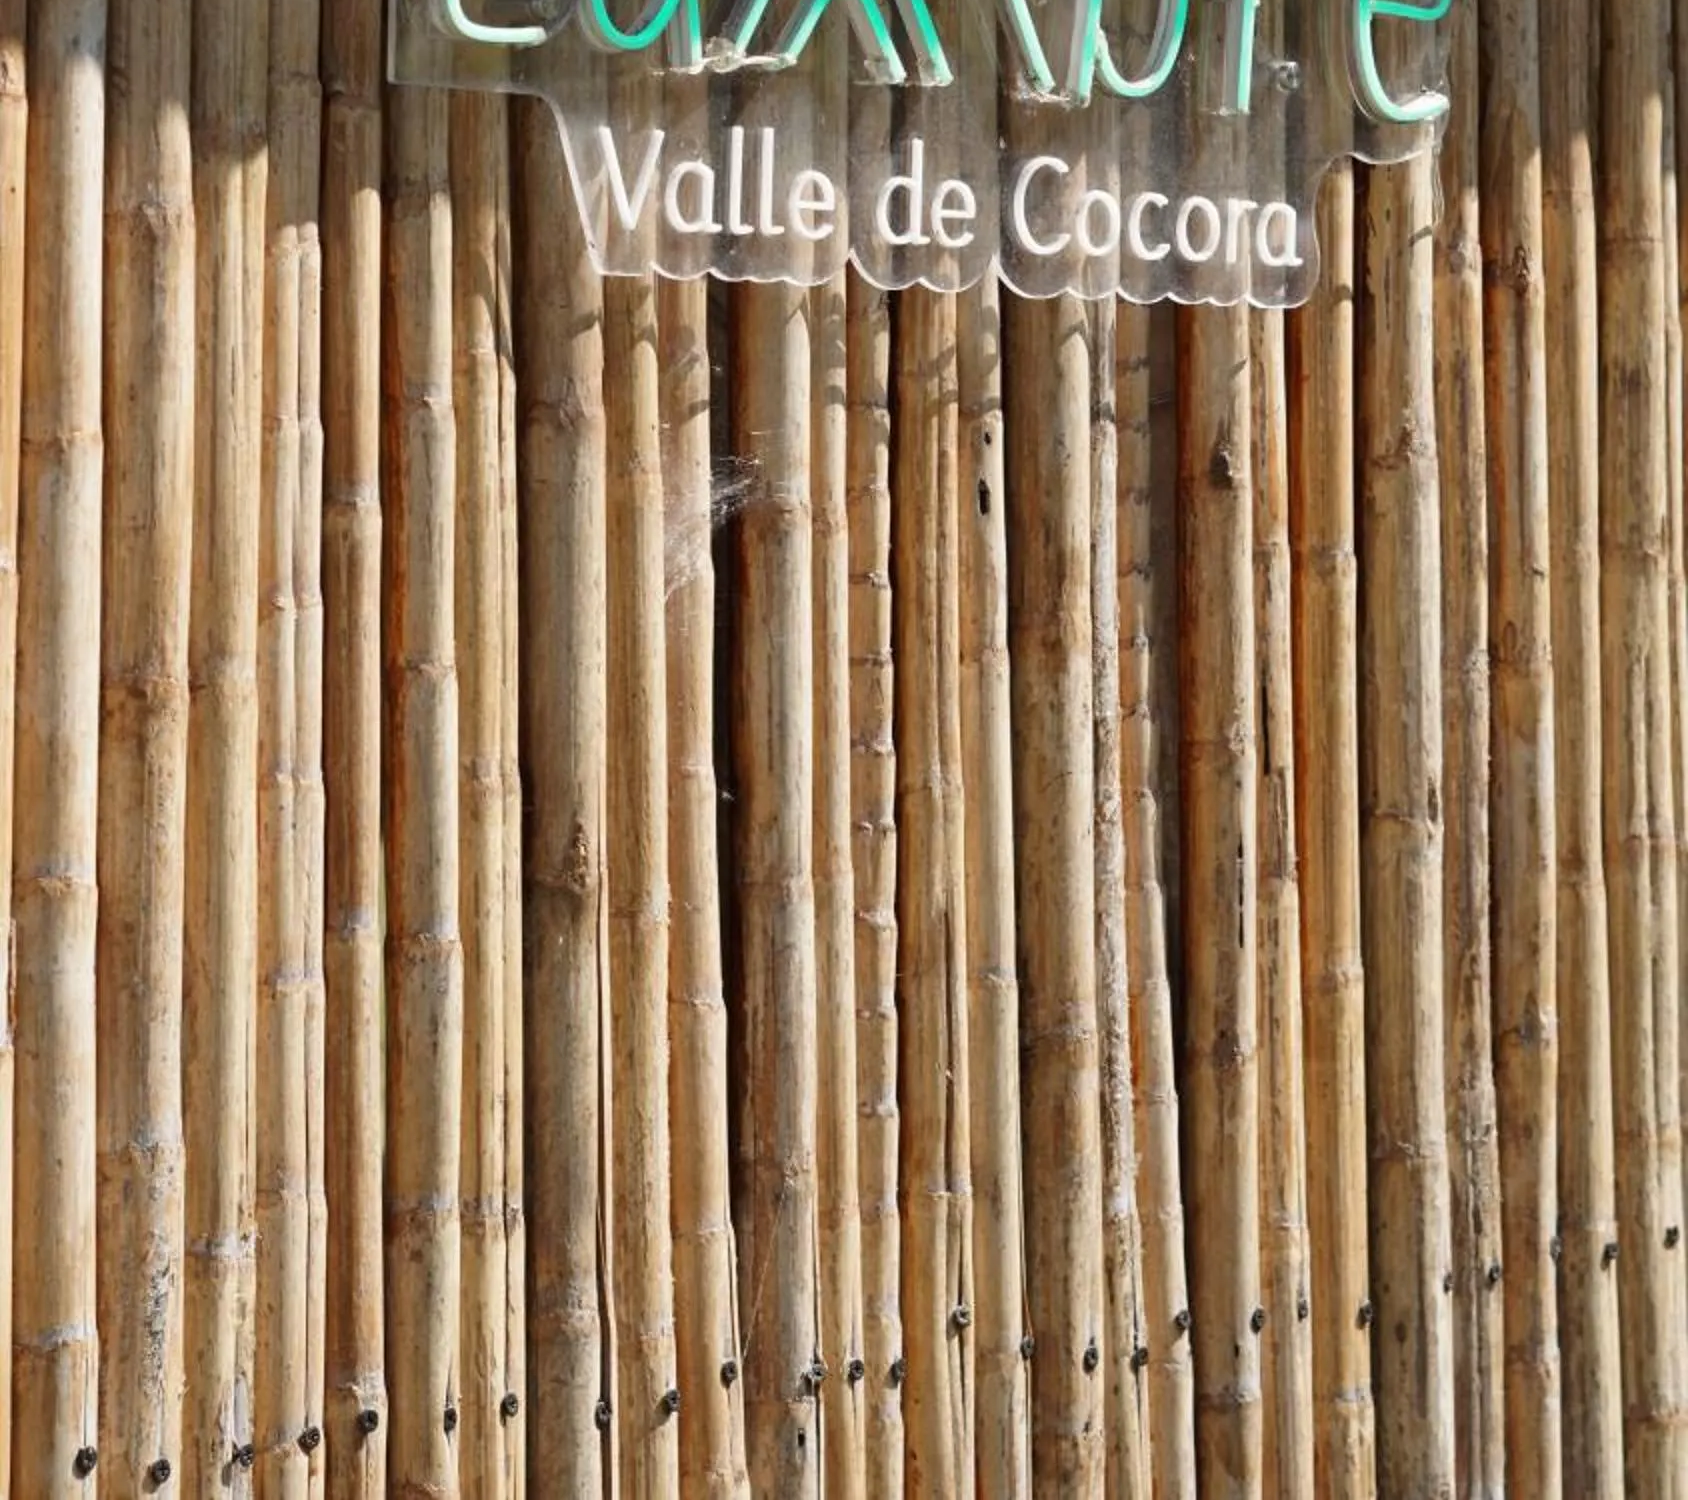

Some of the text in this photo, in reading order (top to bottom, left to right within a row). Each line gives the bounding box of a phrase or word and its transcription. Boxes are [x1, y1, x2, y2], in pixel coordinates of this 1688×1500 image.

[599, 125, 1304, 267] Valle de Cocora
